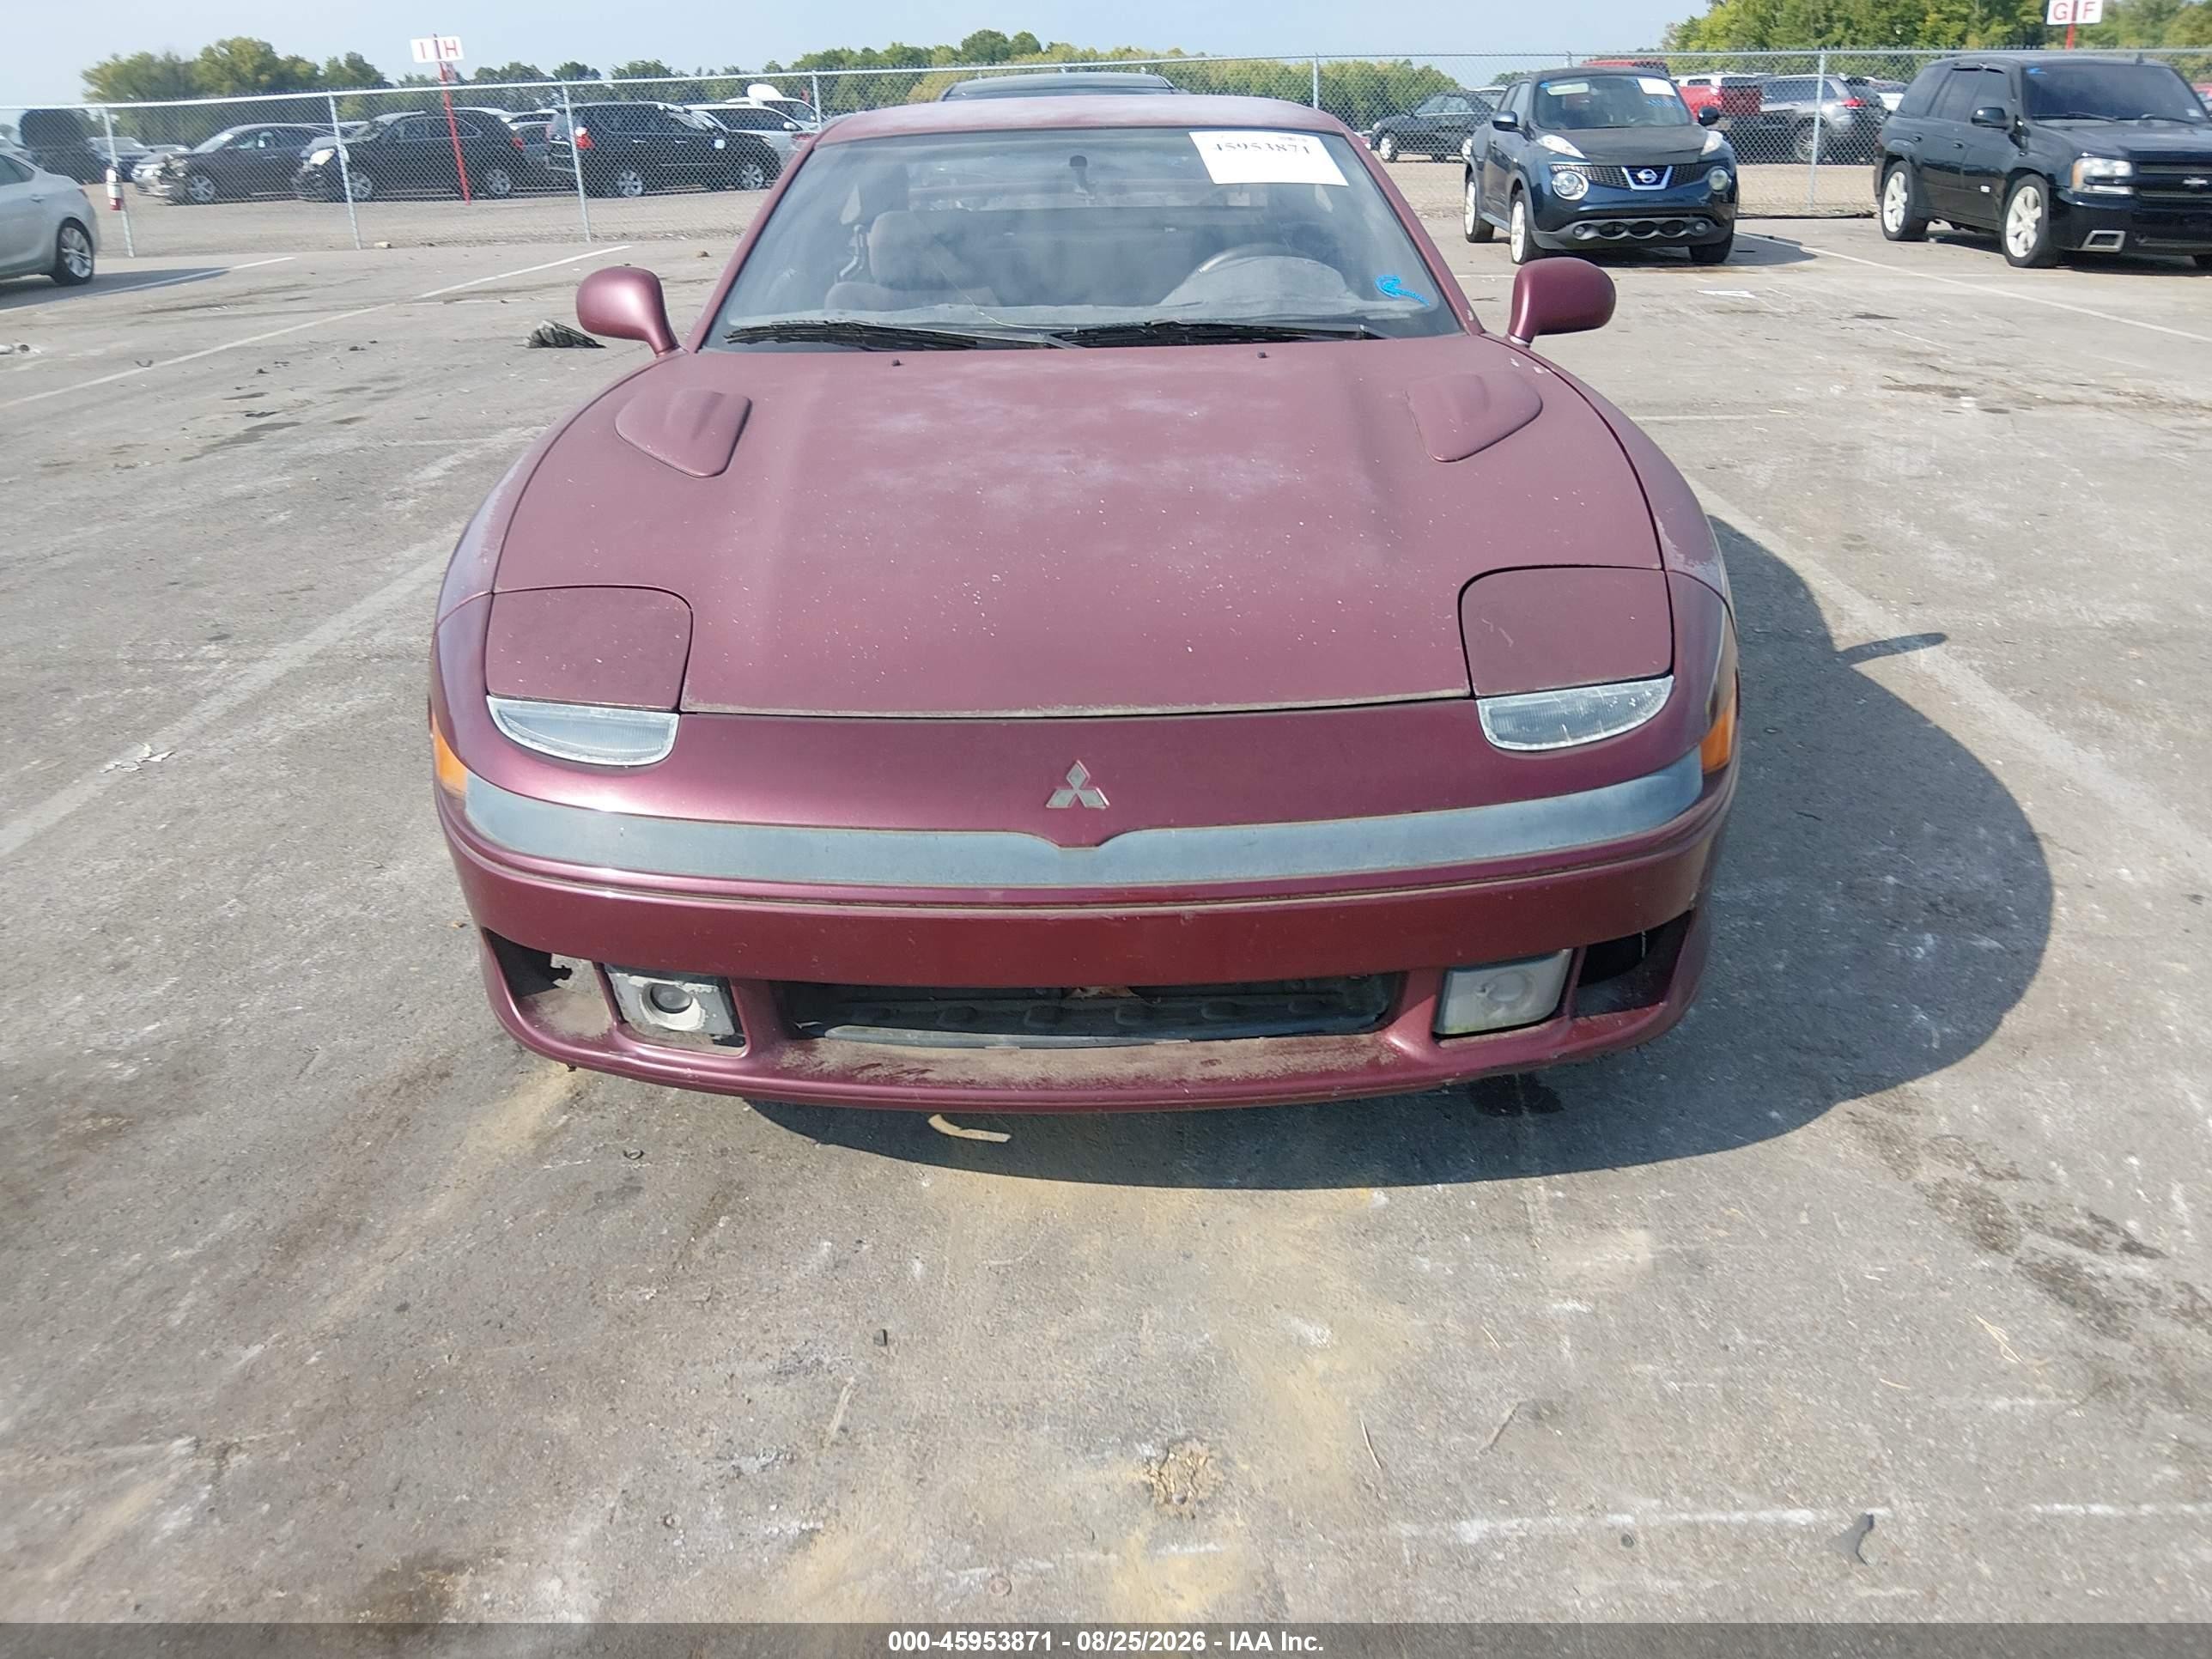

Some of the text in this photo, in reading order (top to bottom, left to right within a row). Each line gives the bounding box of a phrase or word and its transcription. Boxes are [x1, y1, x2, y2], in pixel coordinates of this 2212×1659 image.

[2053, 1, 2096, 21] G F
[443, 39, 459, 58] H
